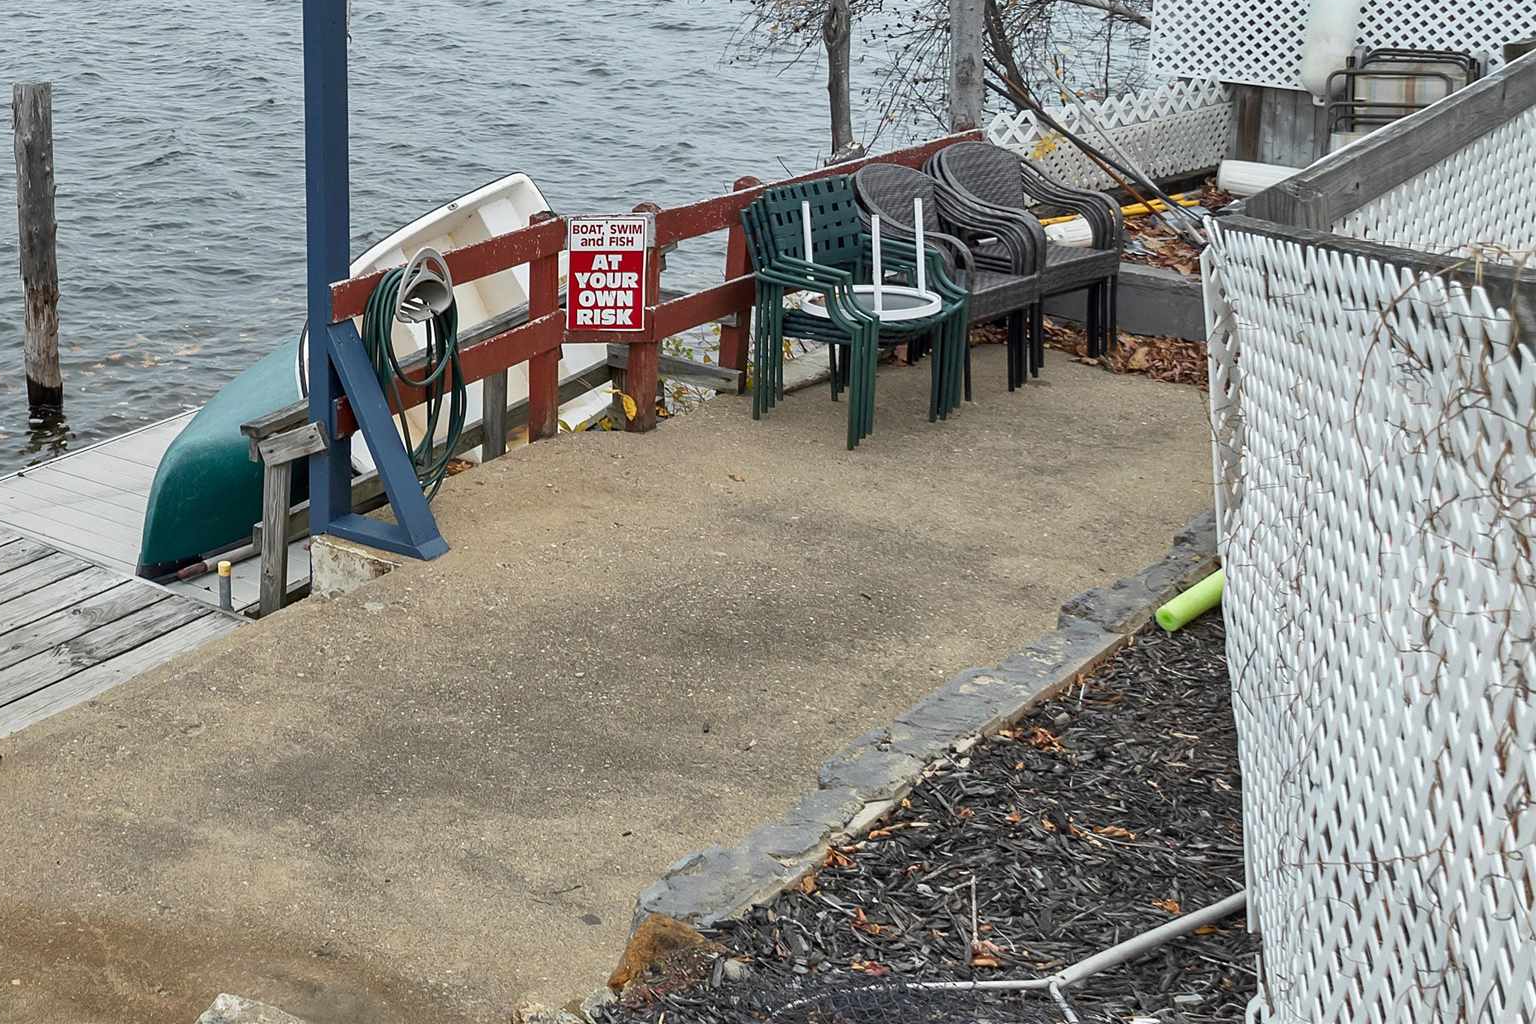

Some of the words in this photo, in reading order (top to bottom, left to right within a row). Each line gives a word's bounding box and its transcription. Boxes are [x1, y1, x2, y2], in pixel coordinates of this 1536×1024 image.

[572, 224, 605, 236] BOAT,
[610, 224, 642, 235] SWIM
[581, 236, 604, 247] and
[609, 236, 634, 247] FISH
[591, 254, 623, 270] AT
[574, 272, 639, 289] YOUR
[578, 290, 633, 307] OWN
[576, 309, 633, 325] RISK
